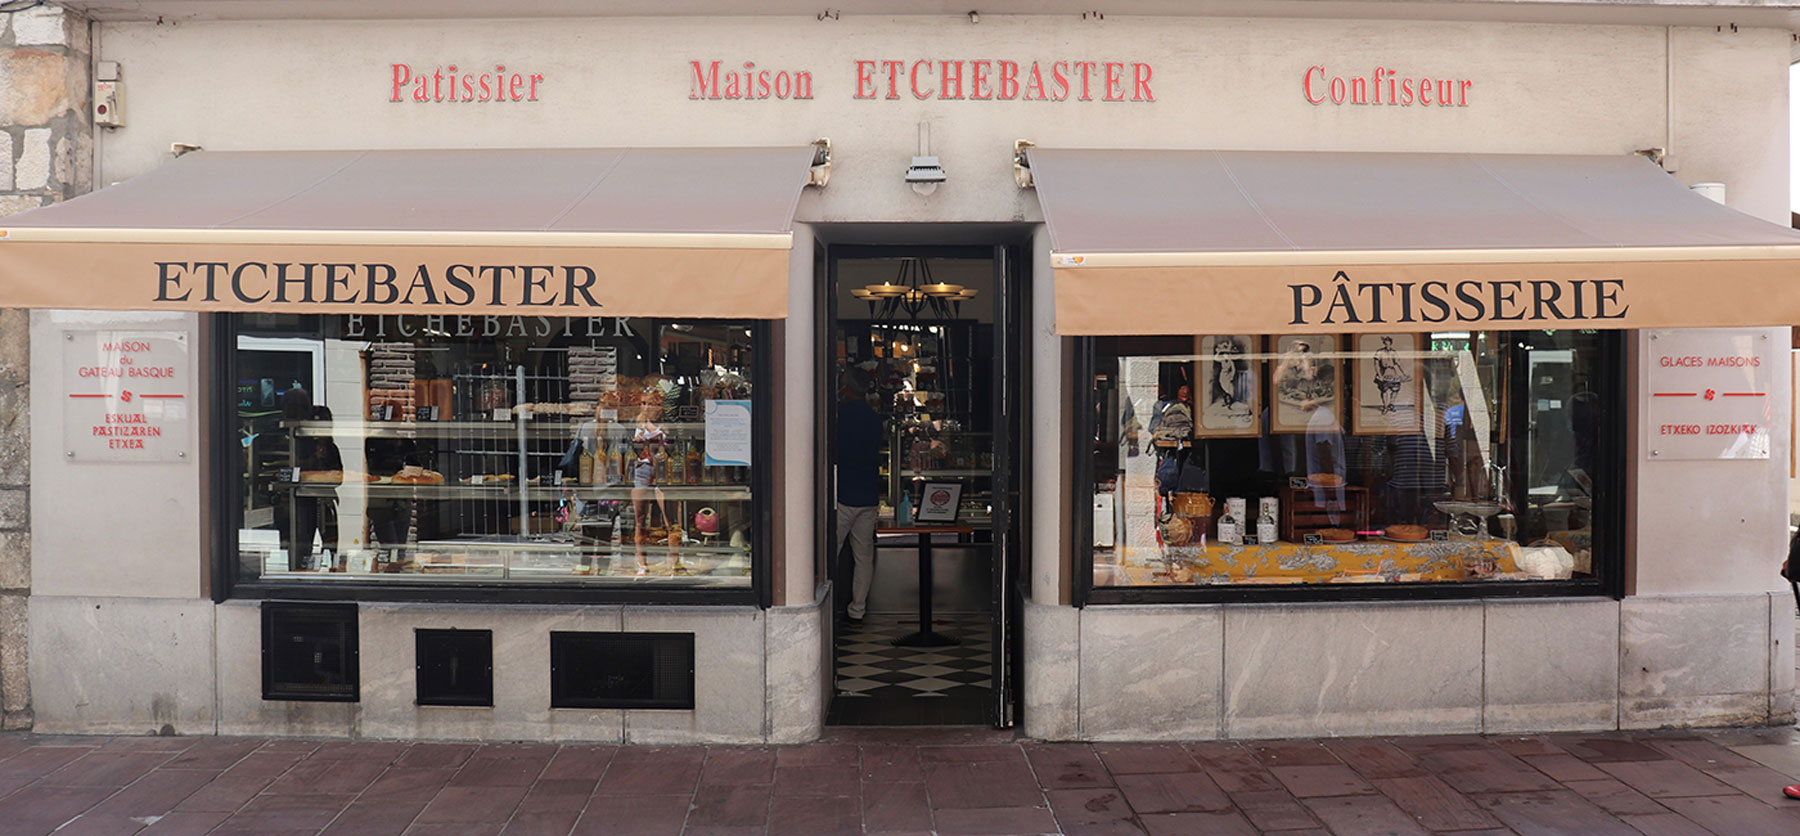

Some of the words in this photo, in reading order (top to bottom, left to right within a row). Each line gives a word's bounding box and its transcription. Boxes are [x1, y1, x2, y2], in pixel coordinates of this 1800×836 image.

[389, 62, 545, 103] Patissier
[689, 60, 814, 101] Maison
[853, 59, 1156, 102] ETCHEBASTER
[1302, 65, 1473, 107] Confiseur
[153, 262, 602, 308] ETCHEBASTER
[1287, 270, 1630, 325] PÂTISSERIE
[102, 341, 151, 353] MAISON
[119, 355, 133, 365] du
[1659, 356, 1704, 368] GLACES
[1707, 356, 1761, 368] MAISONS
[78, 367, 124, 378] GATEAU
[128, 367, 175, 378] BASQUE
[105, 413, 148, 424] ESKUAL
[92, 426, 162, 437] PASTIZAREN
[1660, 424, 1701, 435] ETXEKO
[1706, 424, 1758, 435] IZOZKIAK
[108, 439, 145, 449] ETXEA
